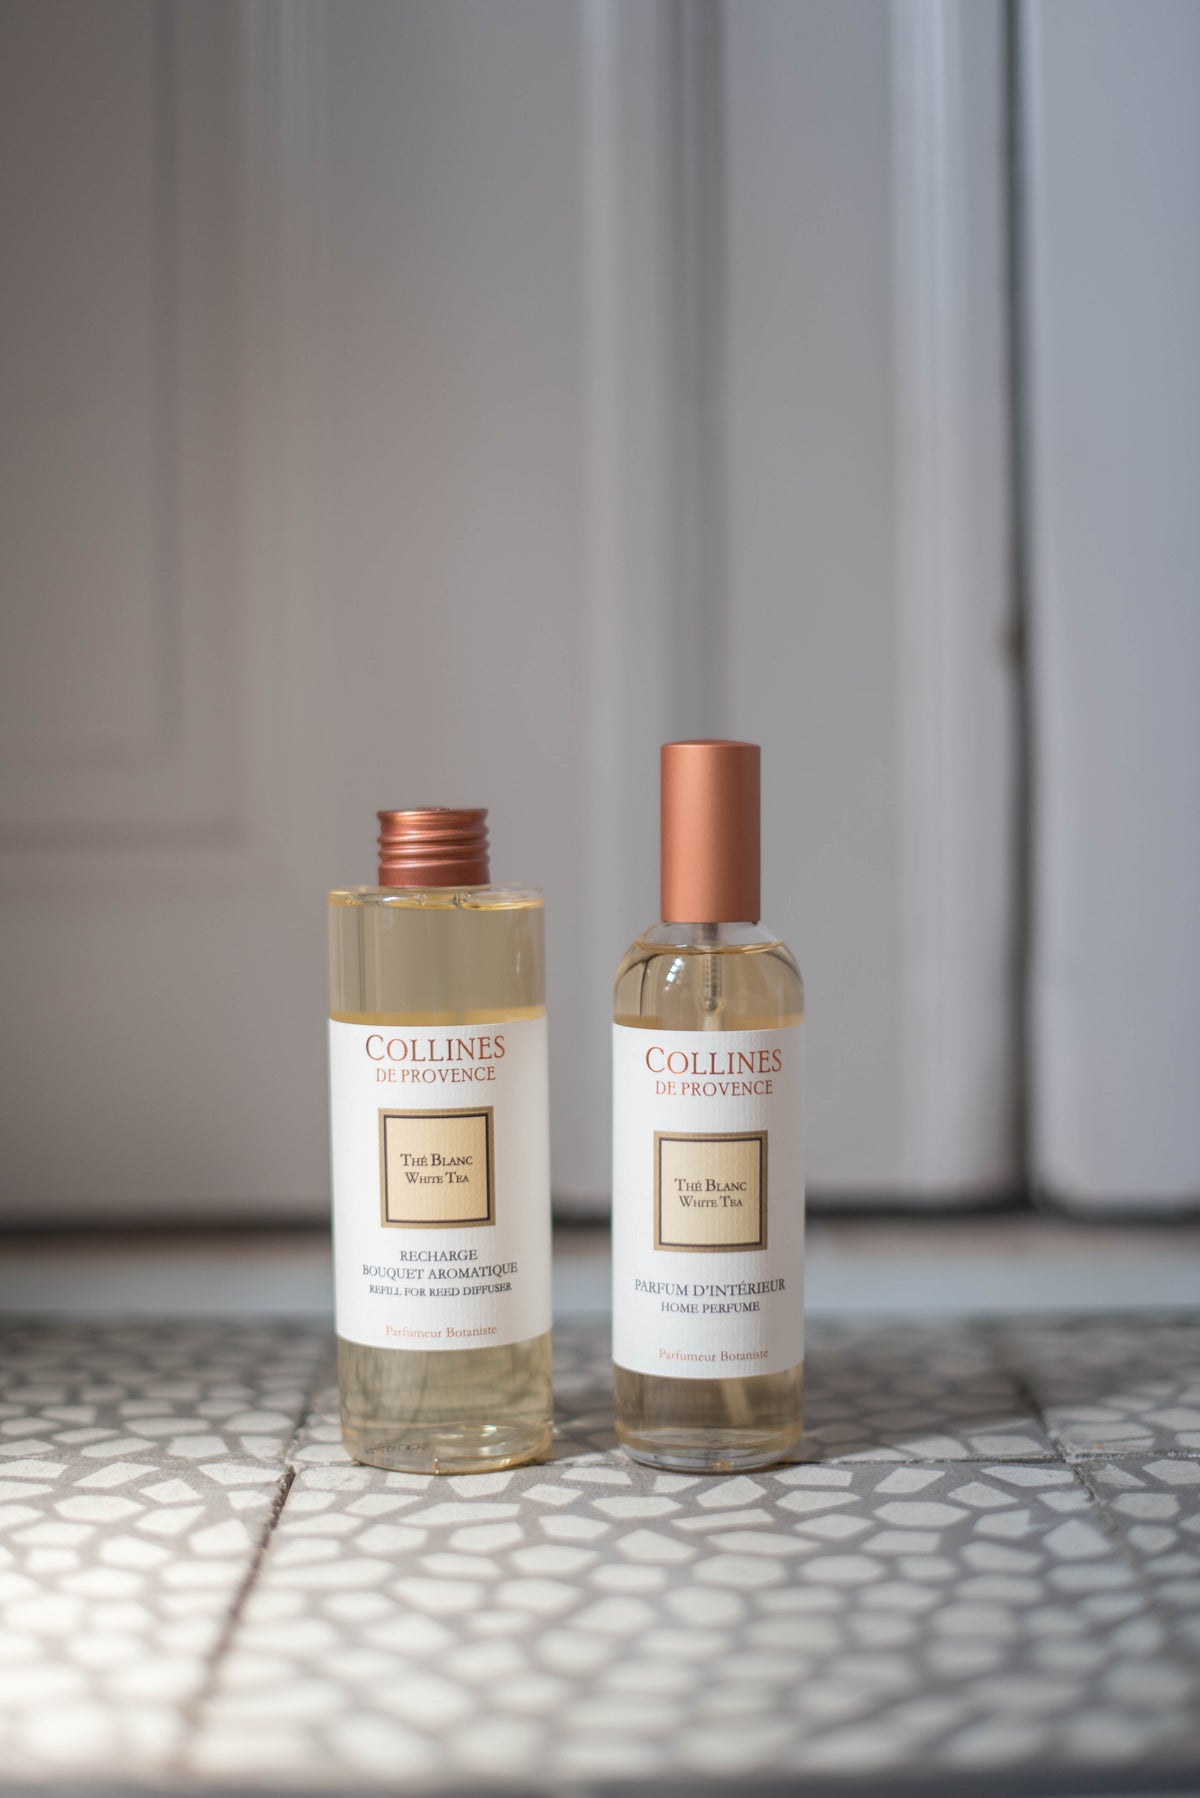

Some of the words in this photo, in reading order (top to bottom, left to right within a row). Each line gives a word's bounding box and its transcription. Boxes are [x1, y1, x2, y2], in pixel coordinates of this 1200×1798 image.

[366, 1034, 505, 1062] COLLINES
[645, 1047, 782, 1075] COLLINES
[376, 1068, 396, 1083] DE
[401, 1066, 496, 1083] PROVENCE
[656, 1080, 676, 1096] DE
[681, 1080, 773, 1097] PROVENCE
[431, 1153, 473, 1166] BLANC
[405, 1172, 443, 1184] WHITE
[445, 1171, 469, 1183] TEA
[705, 1179, 747, 1192] BLANC
[679, 1195, 717, 1208] WHITE
[719, 1195, 743, 1207] TEA
[400, 1249, 478, 1261] RECHARGE
[362, 1264, 424, 1280] BOUQUET
[428, 1261, 518, 1280] AROMATIQUE
[369, 1284, 402, 1296] REFILL
[404, 1287, 426, 1297] FOR
[429, 1286, 460, 1296] REED
[463, 1281, 512, 1295] DIFFUSER
[635, 1278, 689, 1296] PARFUM
[661, 1302, 699, 1313] HOME
[702, 1301, 760, 1313] PERFUME
[385, 1324, 442, 1338] Parfumeur
[446, 1325, 497, 1337] Botaniste
[658, 1348, 716, 1362] Parfumeur
[720, 1348, 769, 1360] Botaniste
